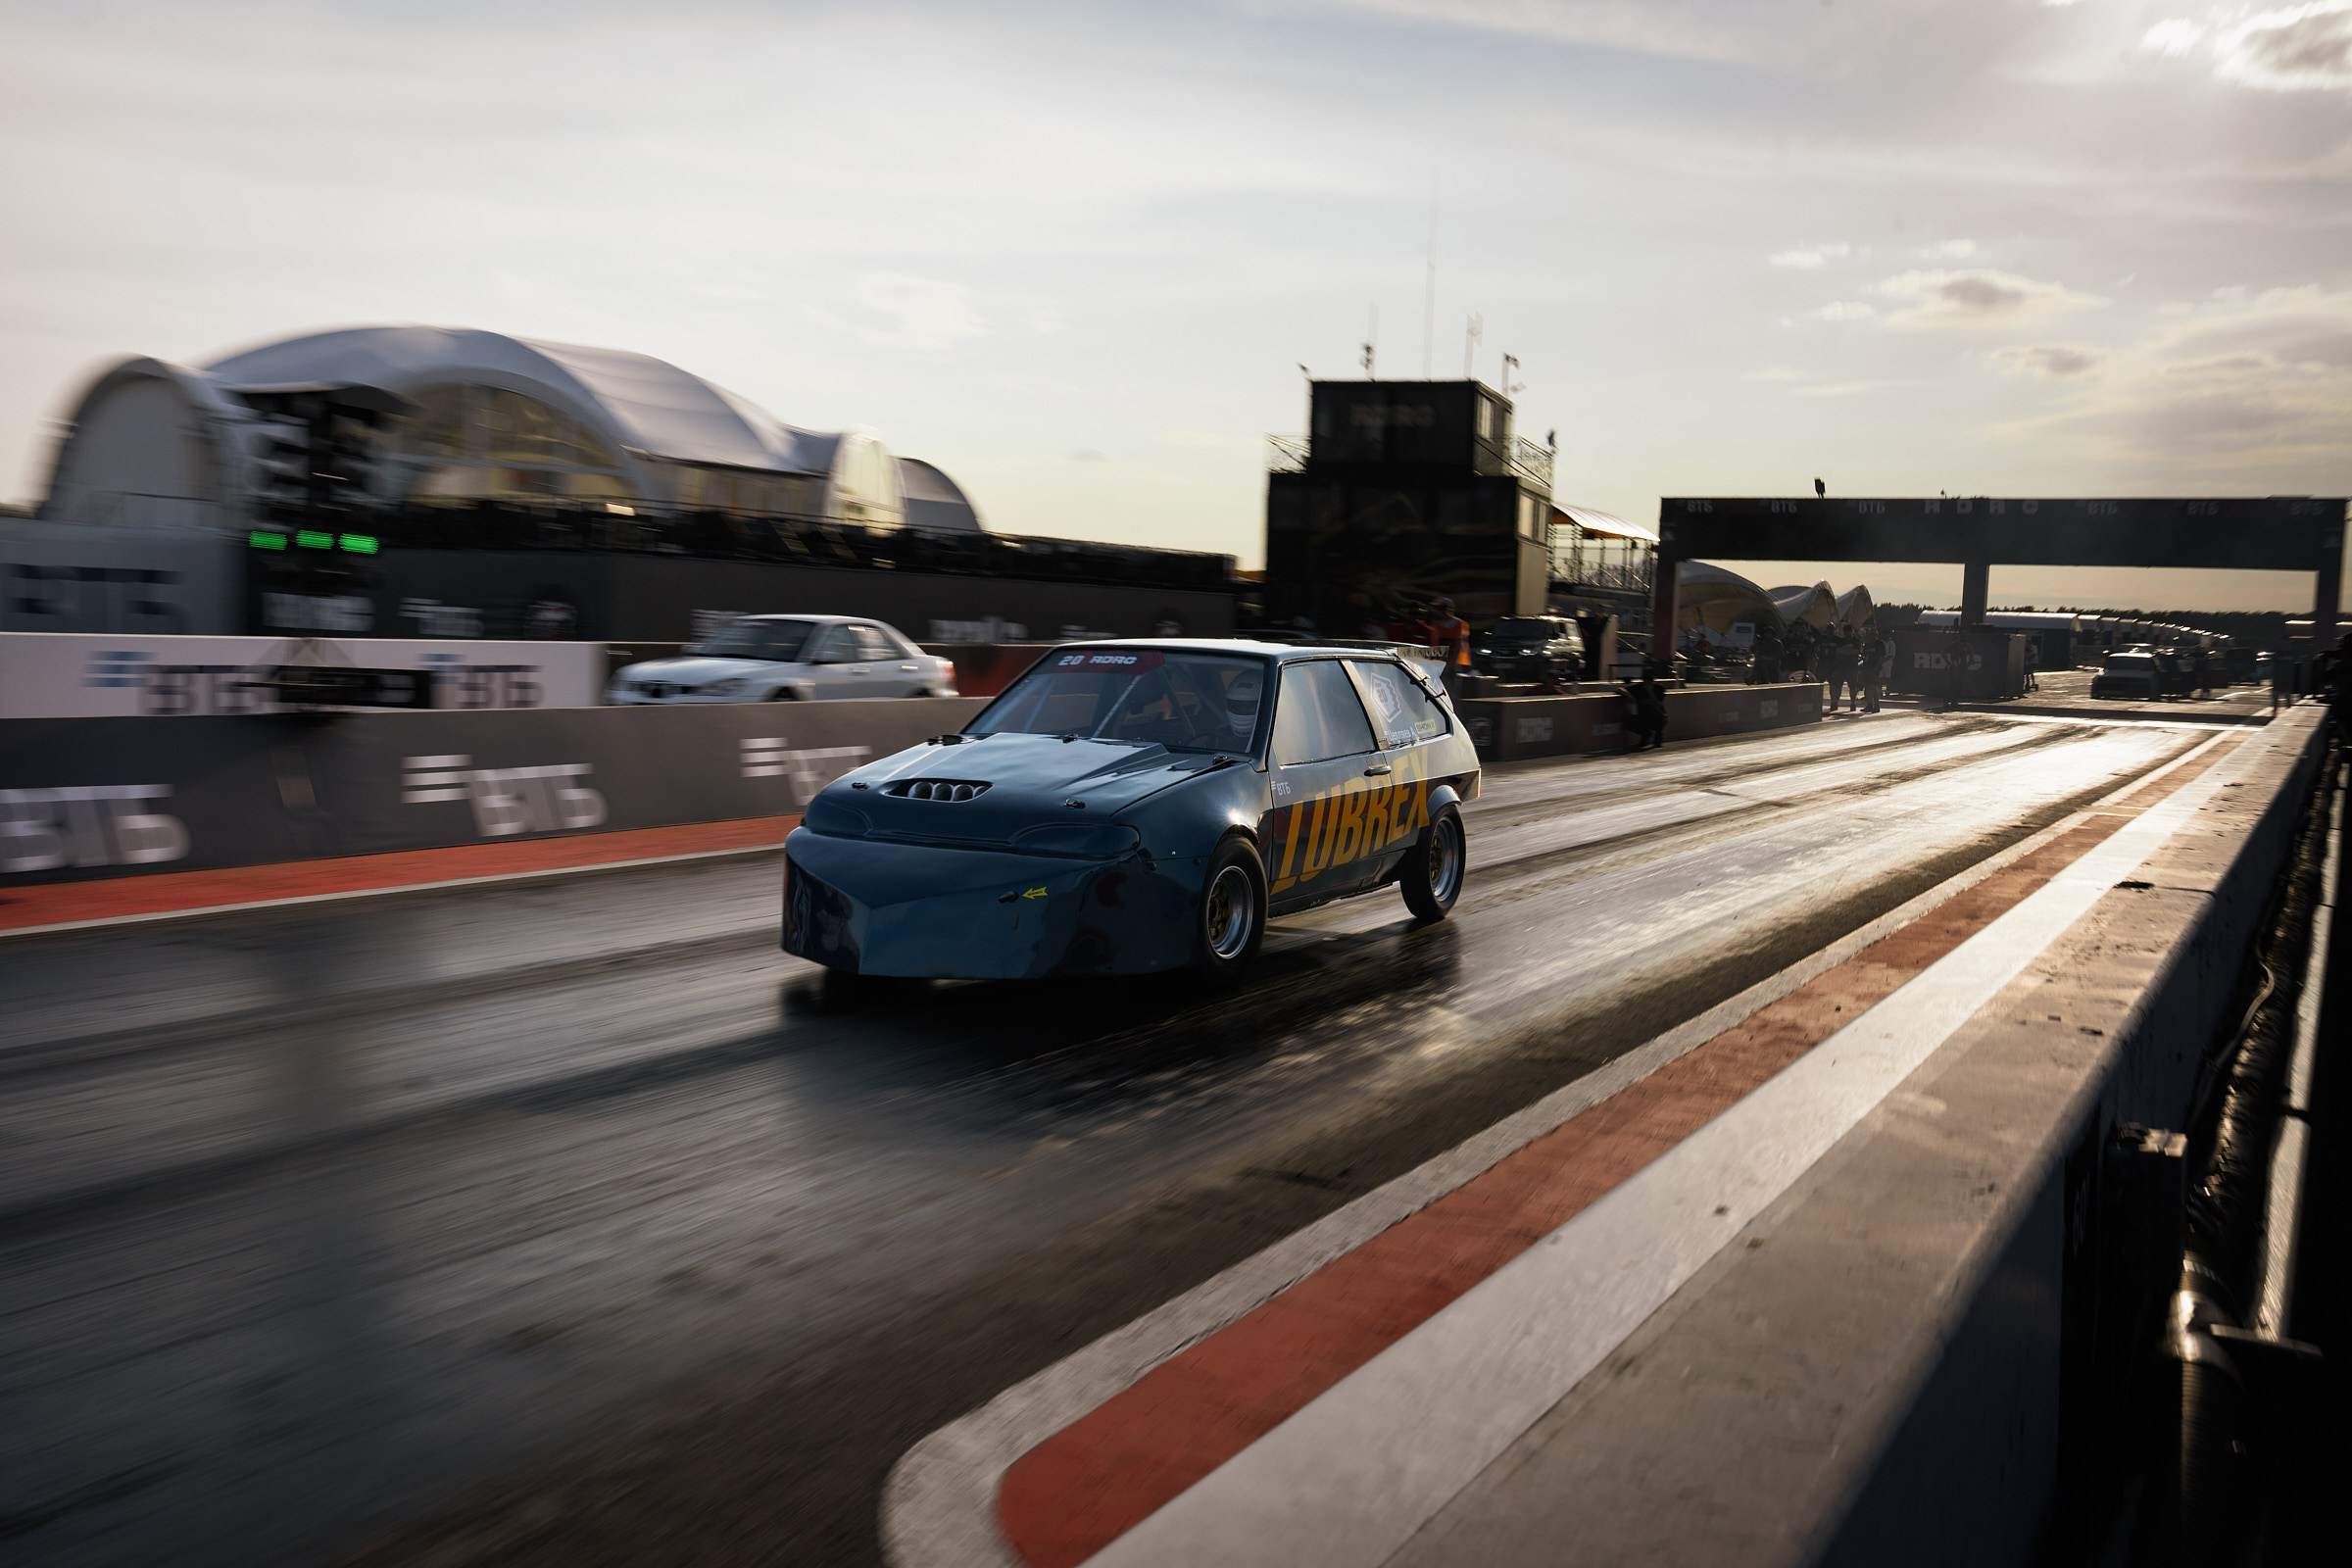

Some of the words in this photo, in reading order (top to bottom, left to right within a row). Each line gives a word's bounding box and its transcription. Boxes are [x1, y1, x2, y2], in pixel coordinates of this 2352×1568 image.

[1058, 655, 1085, 666] 20
[1277, 781, 1291, 796] ВТБ
[1270, 745, 1430, 895] LUBREX
